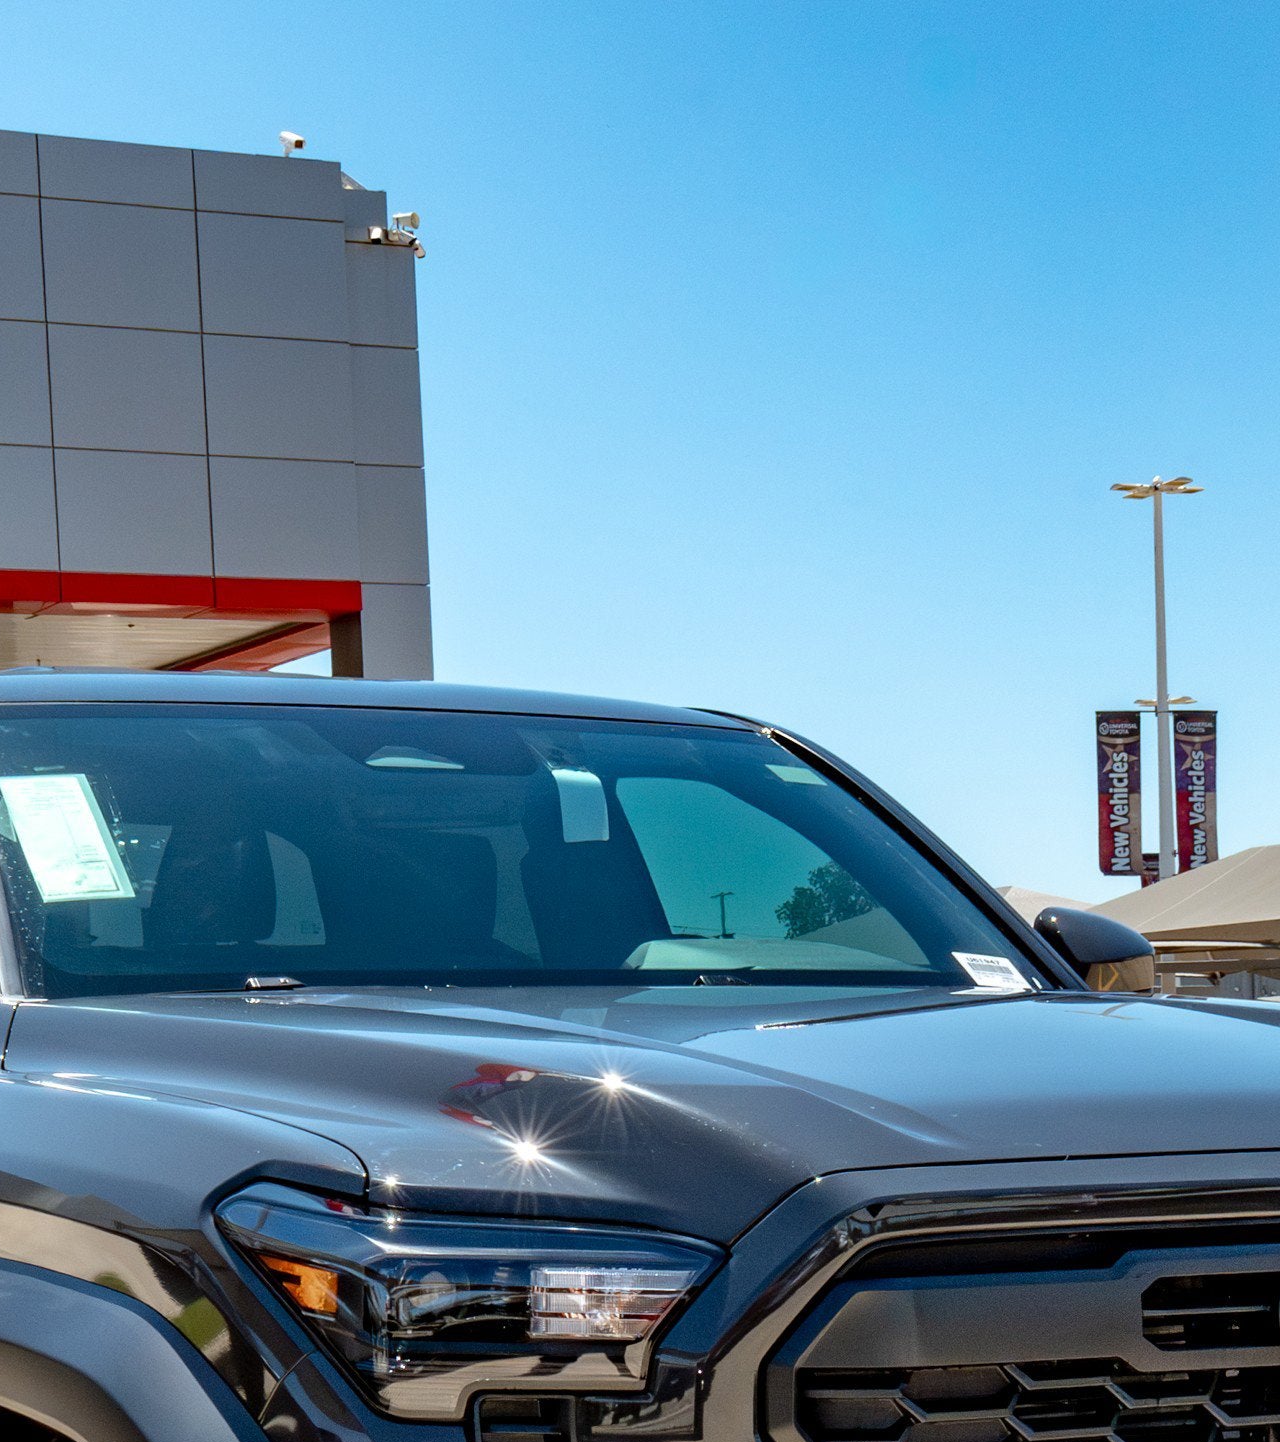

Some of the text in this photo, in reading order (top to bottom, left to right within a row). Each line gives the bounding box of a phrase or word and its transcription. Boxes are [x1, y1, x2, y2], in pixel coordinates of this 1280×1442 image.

[1109, 751, 1131, 872] New Vehicles
[1187, 749, 1208, 869] New Vehicles
